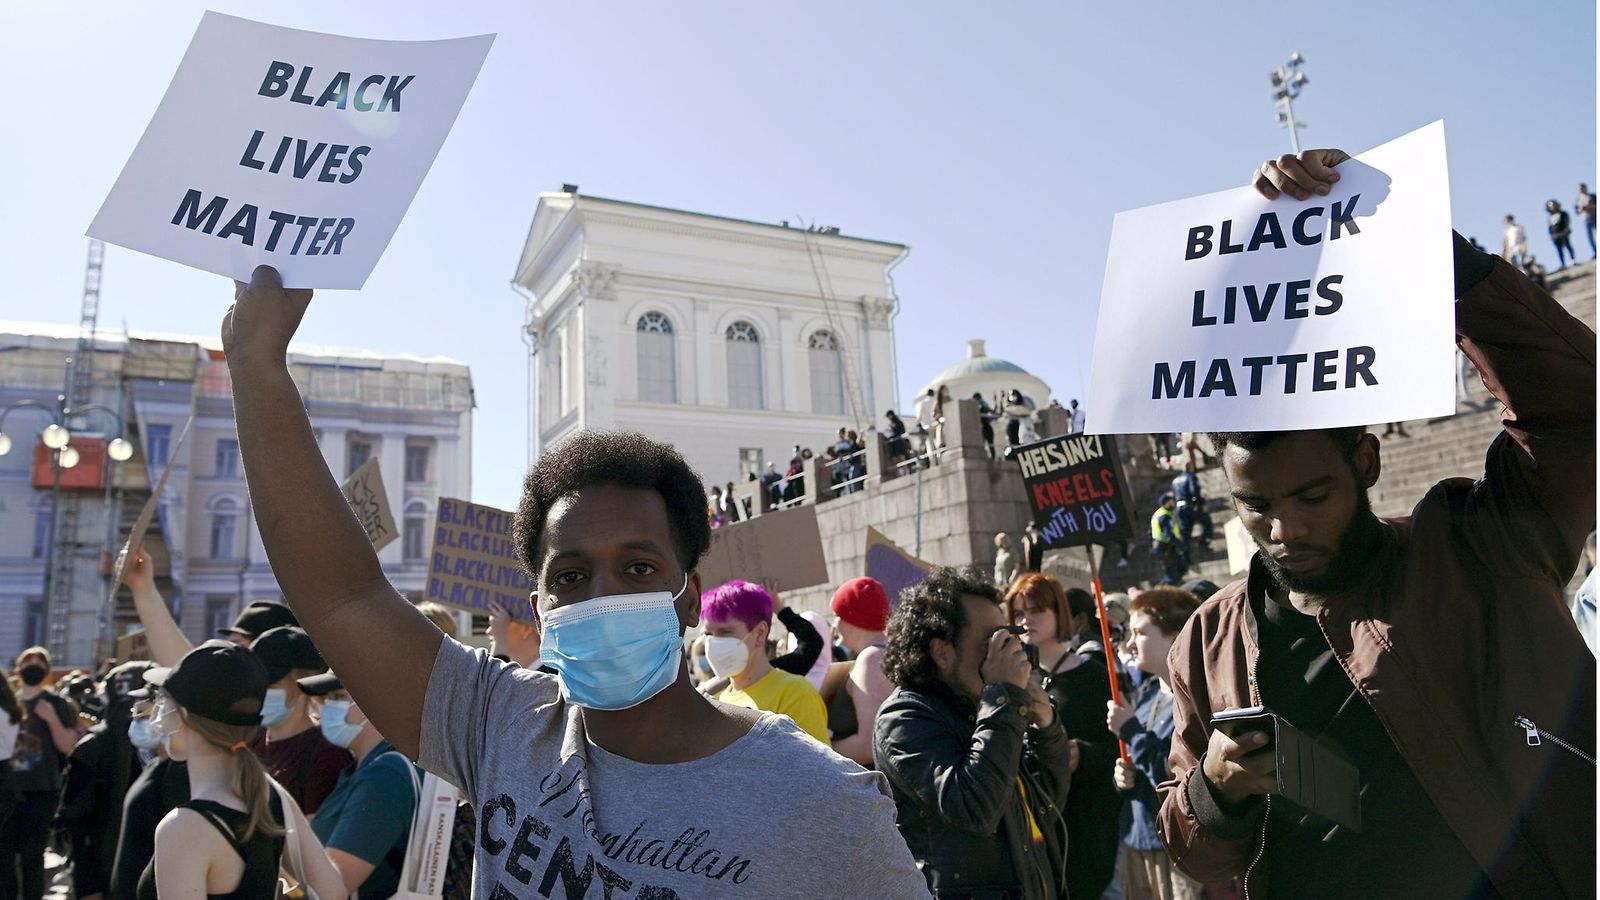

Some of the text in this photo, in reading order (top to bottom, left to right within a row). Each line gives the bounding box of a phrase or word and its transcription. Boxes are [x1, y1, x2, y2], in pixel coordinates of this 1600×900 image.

[257, 60, 416, 113] BLACK
[239, 129, 372, 185] LIVES
[170, 188, 356, 256] MATTER
[1184, 193, 1361, 261] BLACK
[1191, 274, 1344, 327] LIVES
[1151, 345, 1379, 400] MATTER
[1017, 434, 1104, 479] HELSINKI
[1032, 468, 1115, 511] KNEELS
[1040, 502, 1117, 544] WITH YOU
